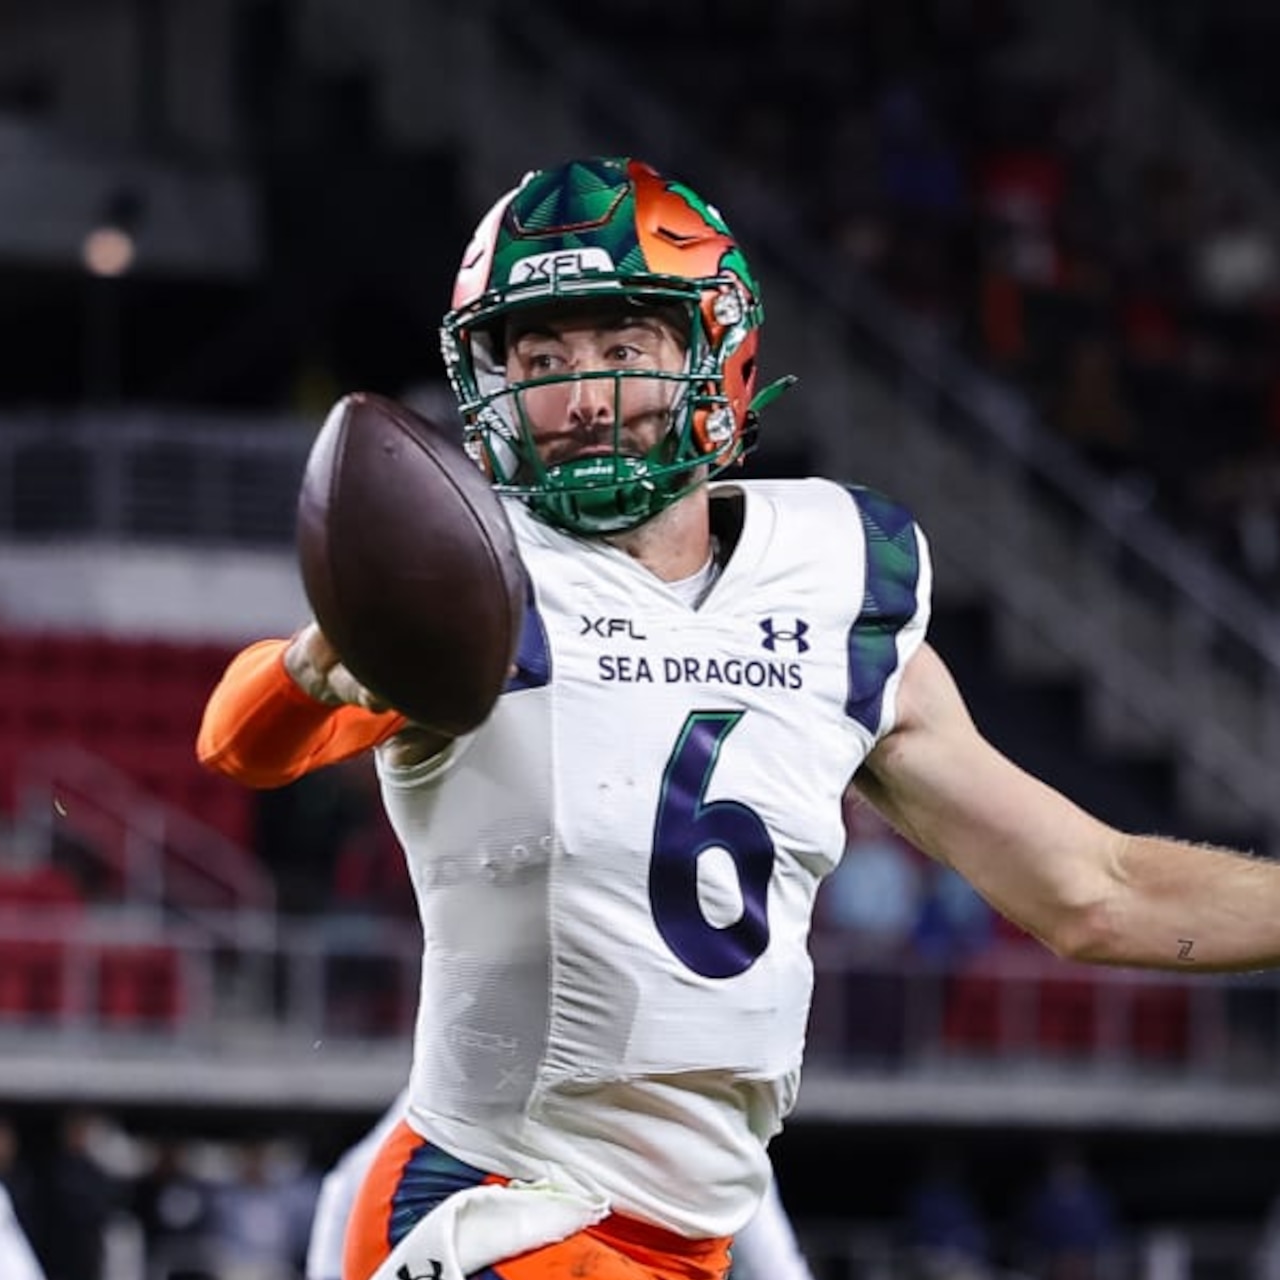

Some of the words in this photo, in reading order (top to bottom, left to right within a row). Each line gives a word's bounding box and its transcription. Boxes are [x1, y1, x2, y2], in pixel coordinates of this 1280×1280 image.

[524, 254, 600, 281] XFL
[580, 615, 647, 640] XFL
[598, 656, 654, 683] SEA
[663, 657, 803, 690] DRAGONS
[648, 709, 775, 980] 6
